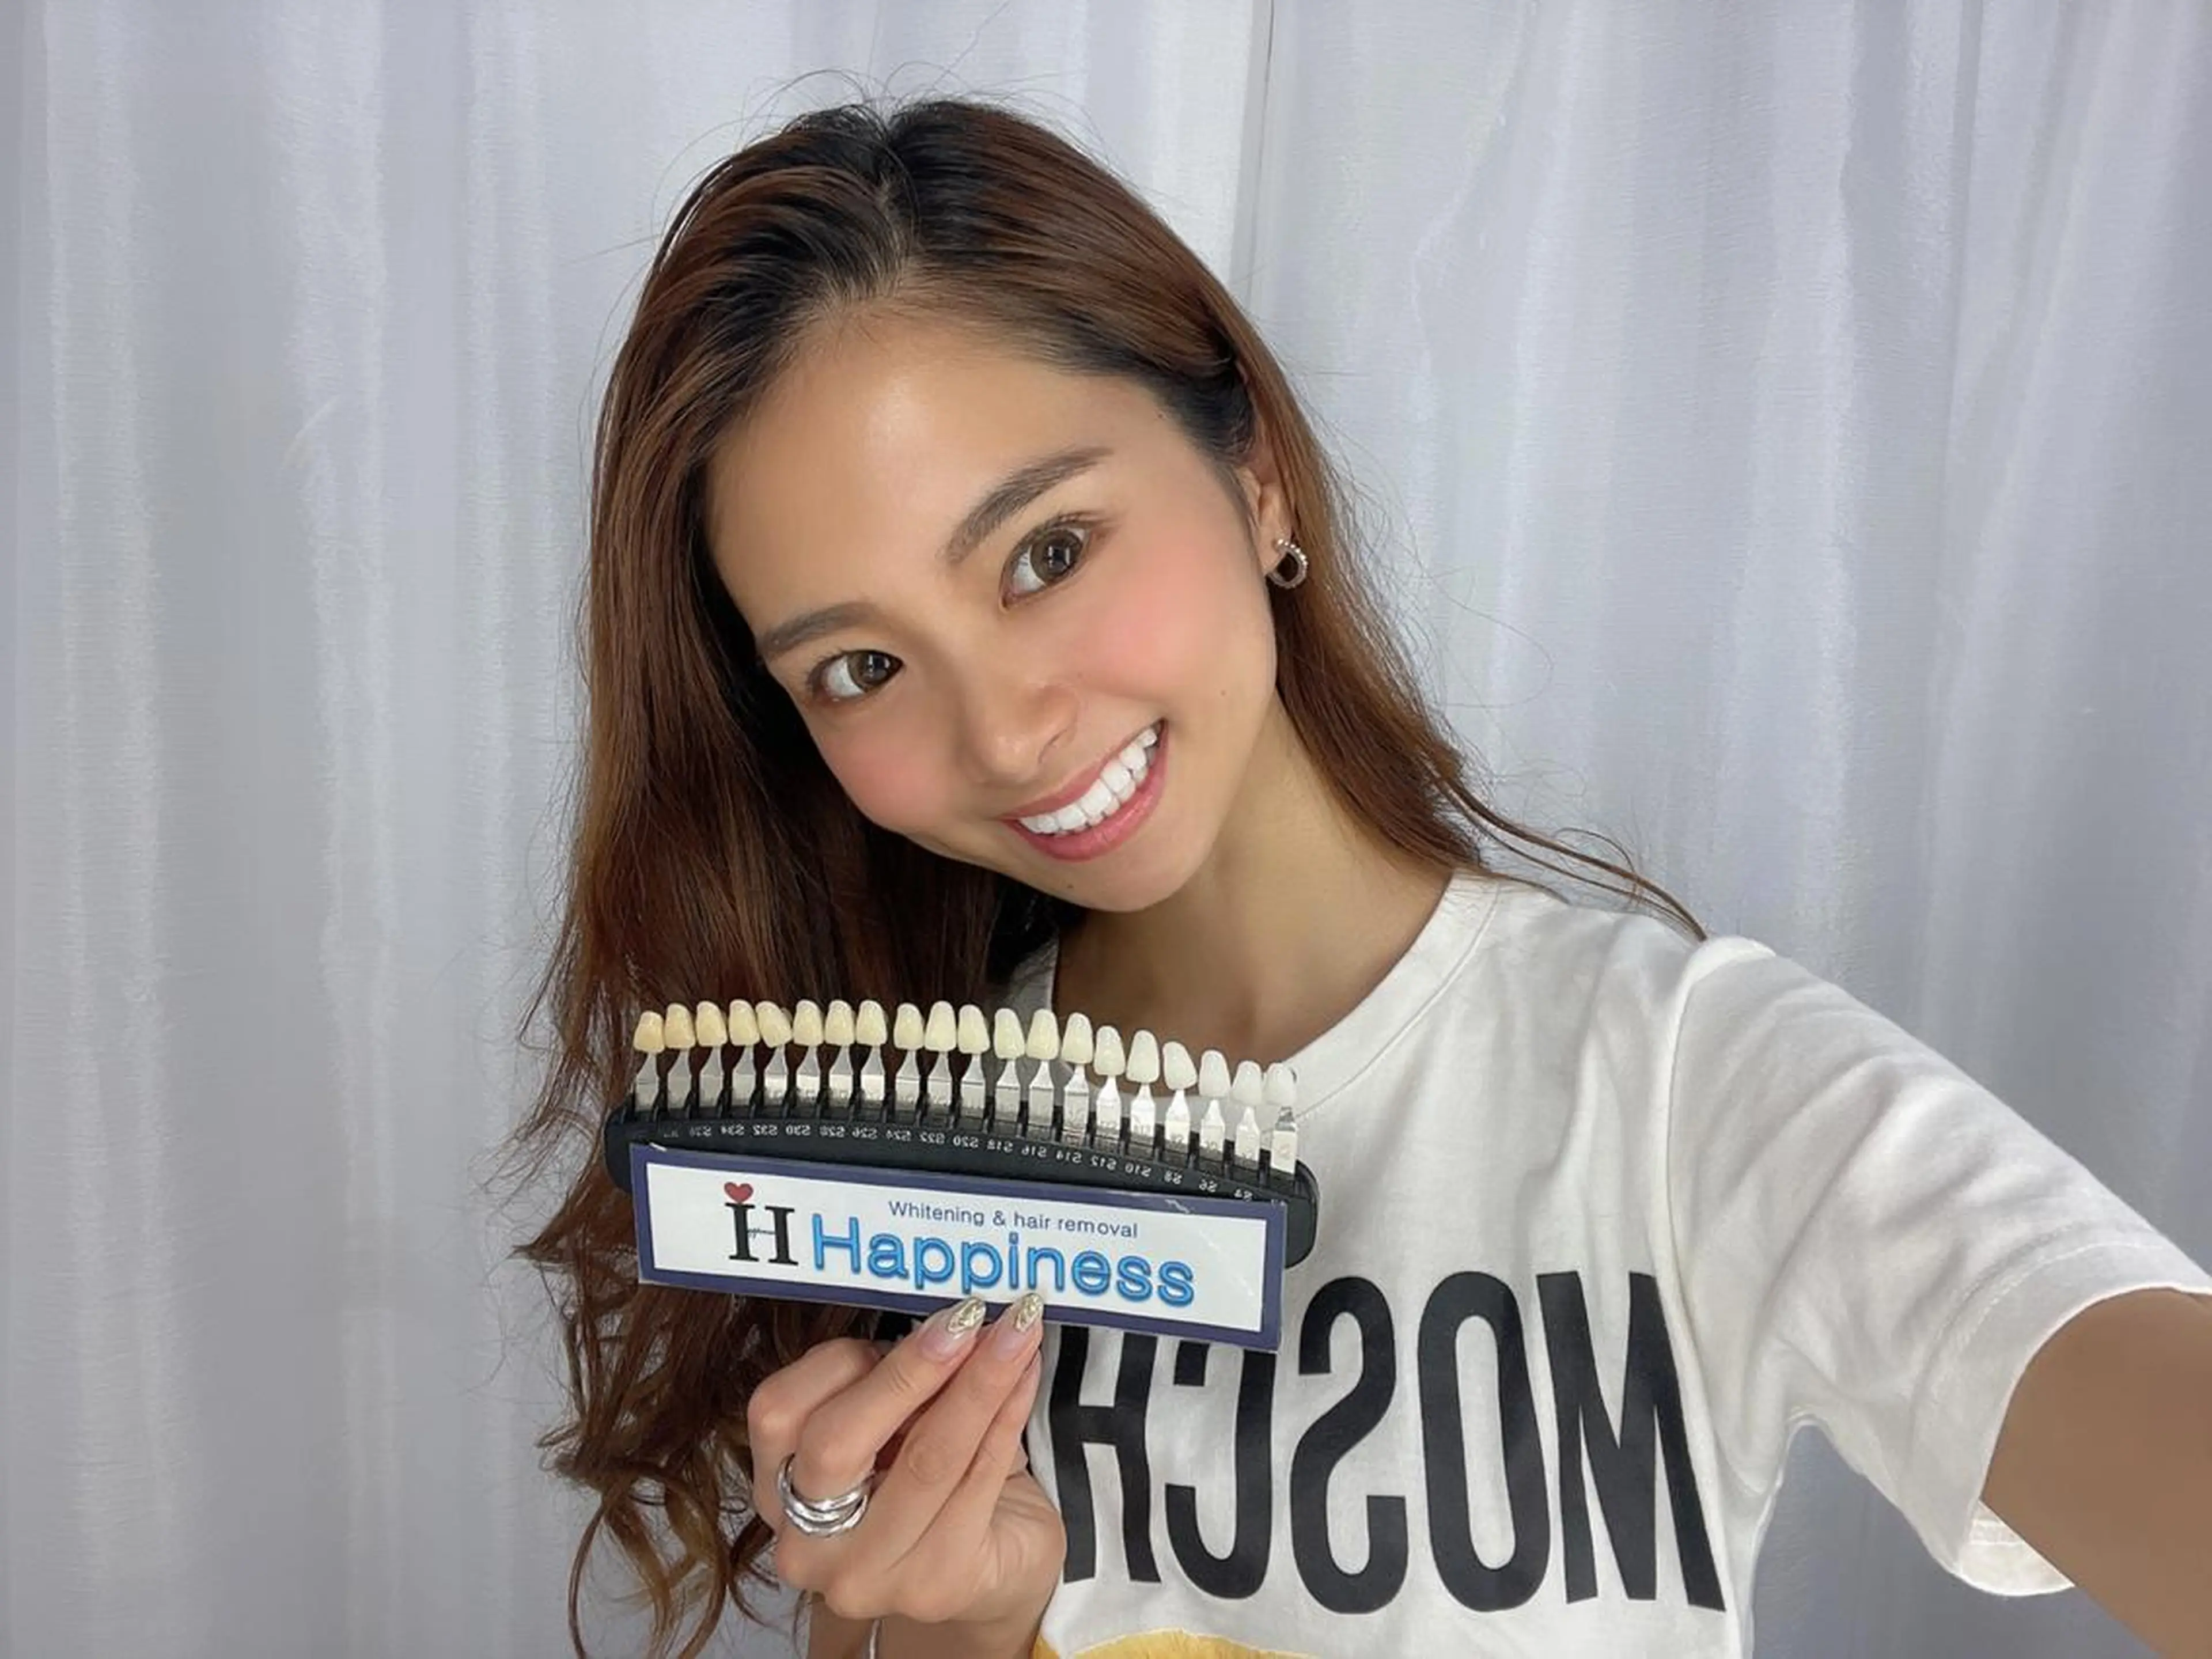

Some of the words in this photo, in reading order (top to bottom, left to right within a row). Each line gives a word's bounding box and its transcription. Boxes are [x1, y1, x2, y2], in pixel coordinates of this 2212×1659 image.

[889, 1200, 984, 1226] Whitening
[993, 1210, 1006, 1226] &
[1014, 1211, 1051, 1230] hair
[1058, 1217, 1138, 1238] removal
[812, 1213, 1195, 1306] Happiness
